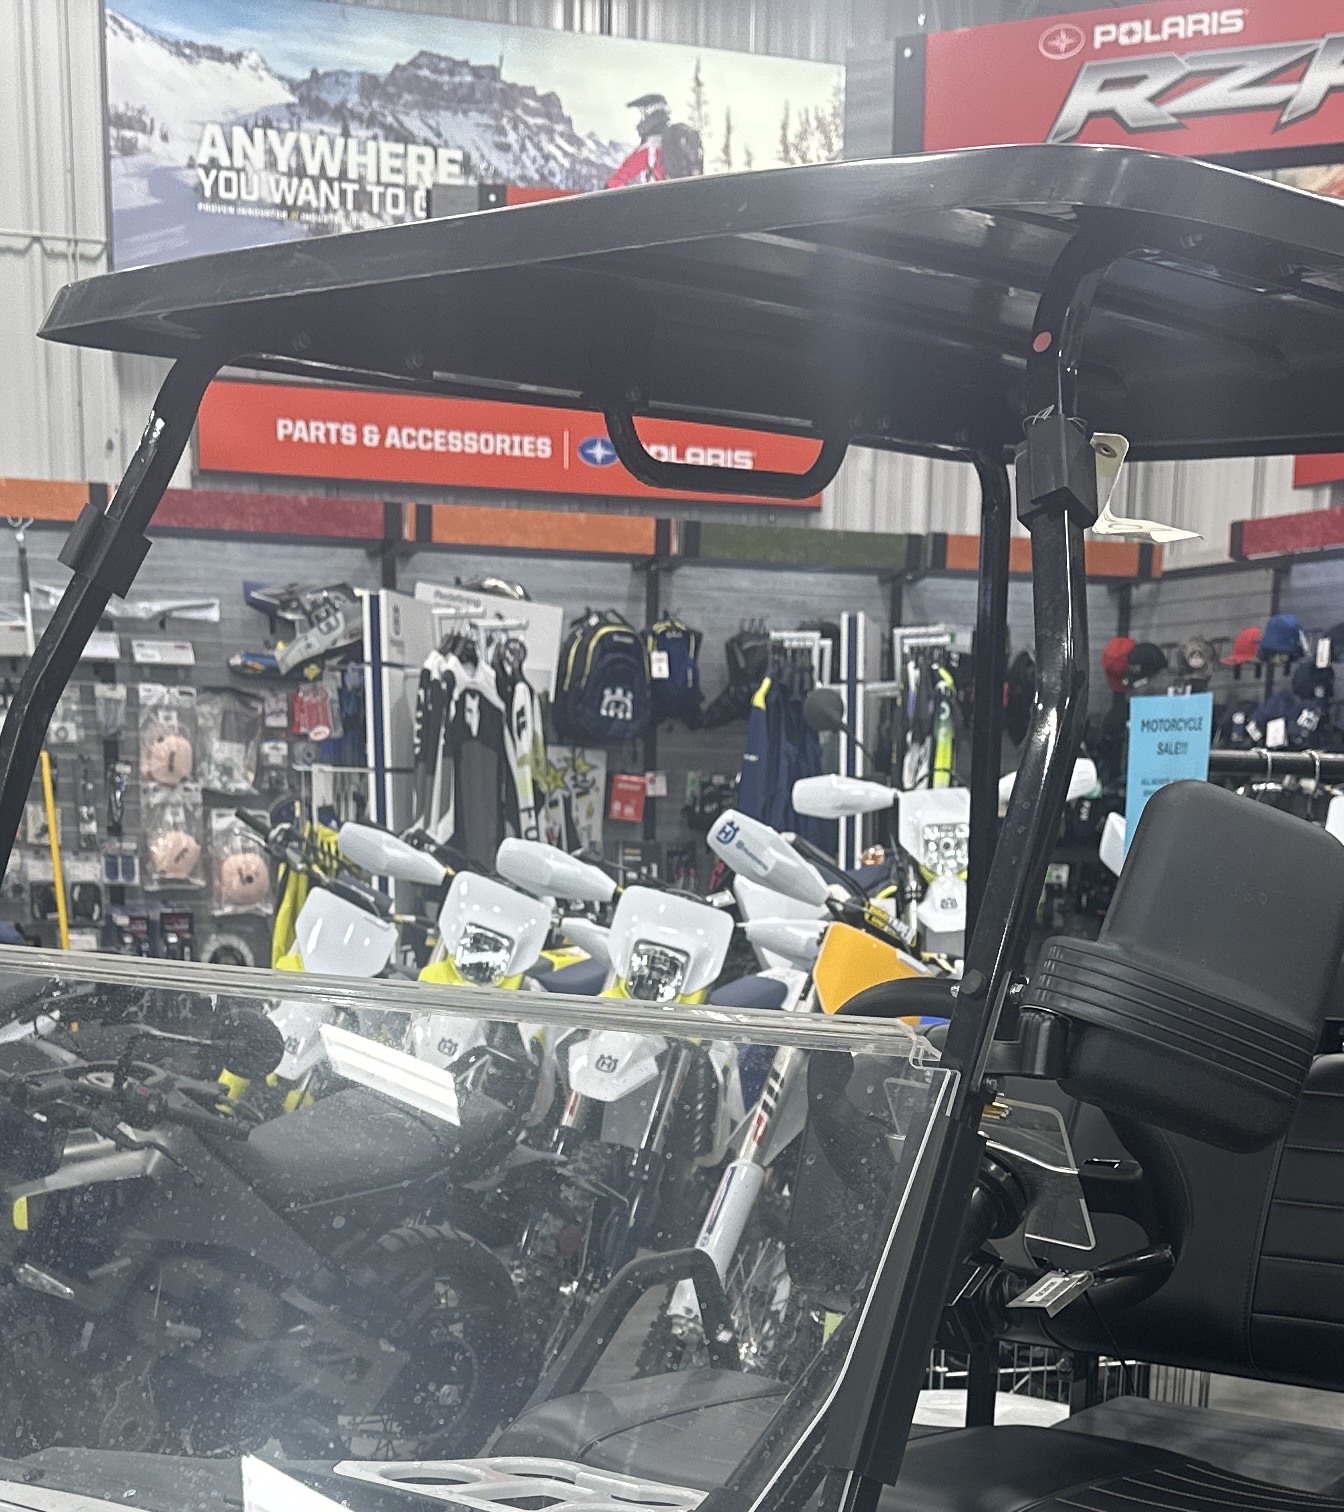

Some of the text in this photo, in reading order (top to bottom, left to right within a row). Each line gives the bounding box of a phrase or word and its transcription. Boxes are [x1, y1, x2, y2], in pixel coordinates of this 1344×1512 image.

[1093, 9, 1246, 50] POLARIS
[196, 122, 464, 190] ANYWHERE
[196, 167, 258, 203] YOU
[268, 173, 359, 212] WANT
[366, 187, 407, 217] TO
[276, 417, 754, 470] PARTS & ACCESSORIES OLARIS
[1140, 716, 1203, 733] MOTORCYCLE
